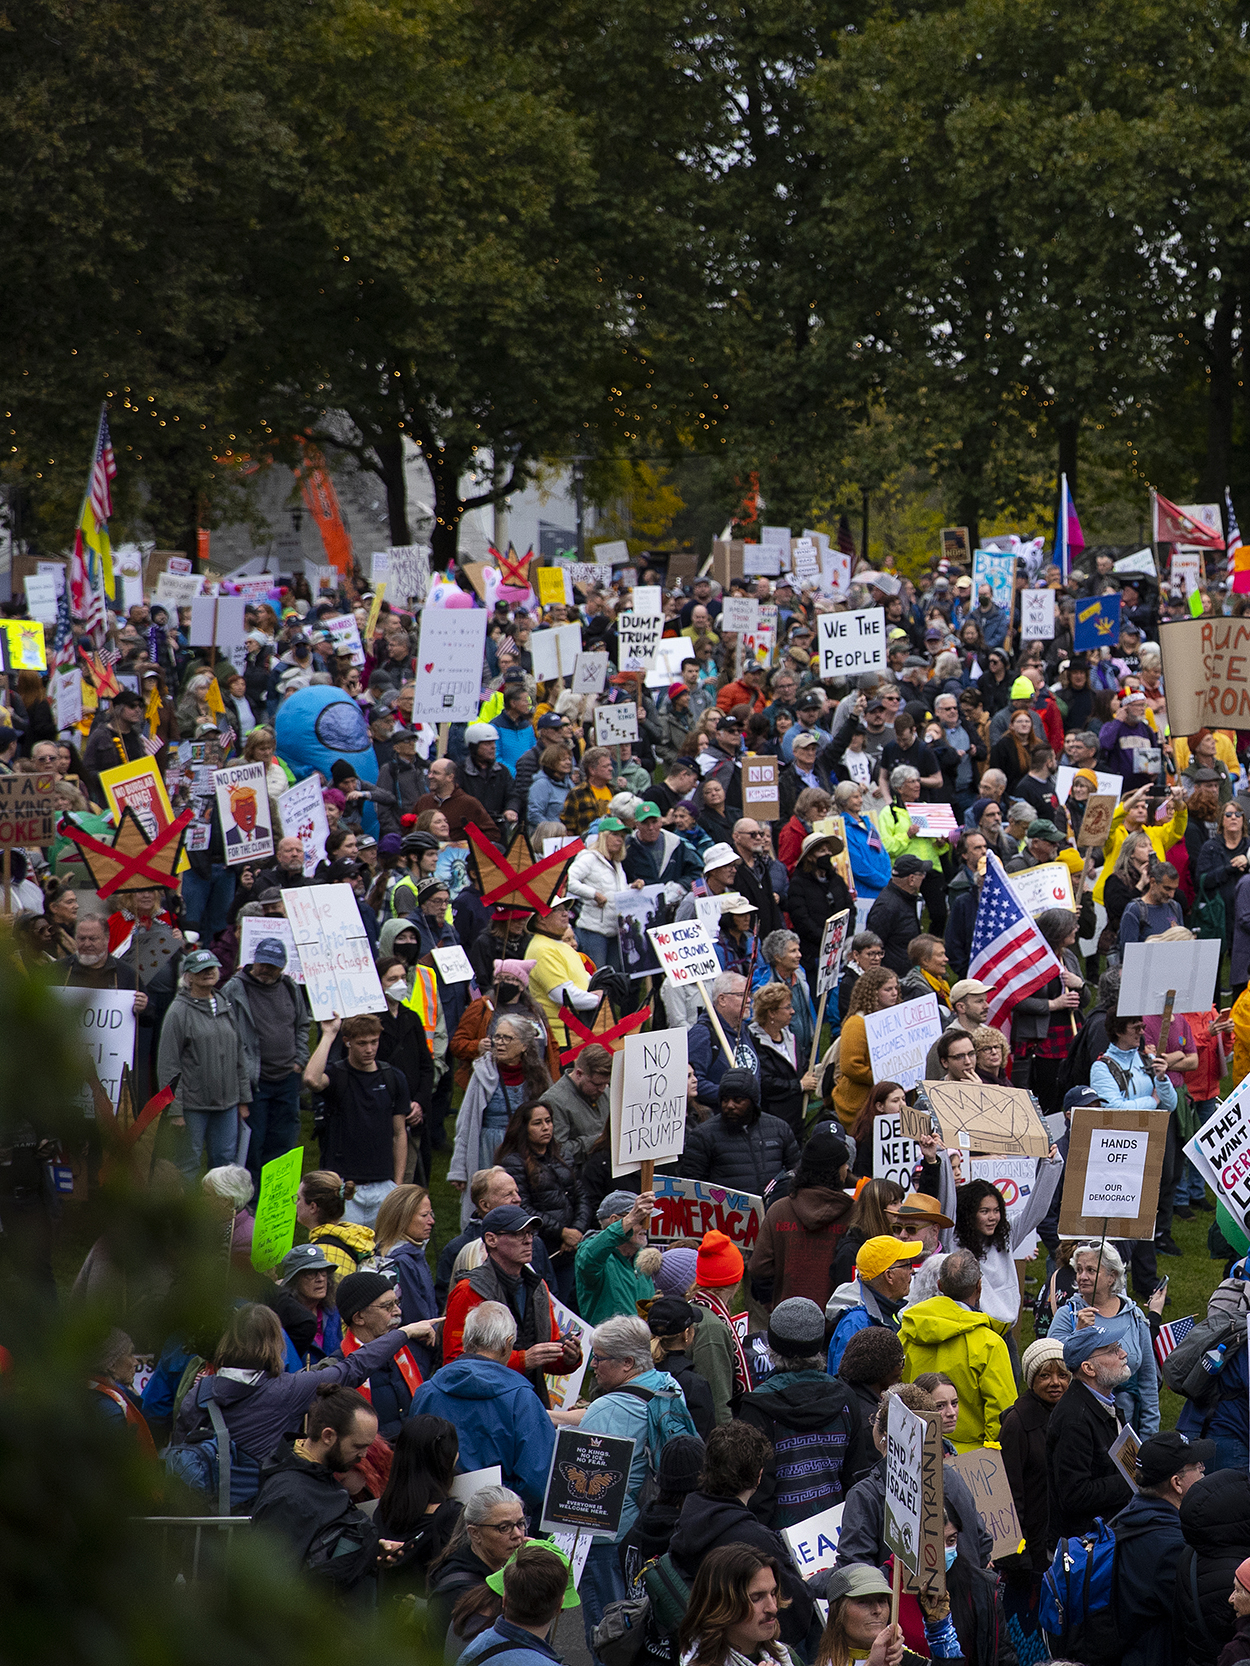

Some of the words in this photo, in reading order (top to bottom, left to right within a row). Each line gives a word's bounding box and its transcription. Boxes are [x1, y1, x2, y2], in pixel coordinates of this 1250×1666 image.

[621, 615, 661, 630] DUMP
[825, 620, 848, 639] WE
[856, 615, 881, 637] THE
[620, 631, 659, 644] TRUMP
[628, 646, 656, 659] NOW
[824, 648, 881, 670] PEOPLE
[216, 772, 230, 786] NO
[230, 765, 264, 784] CROWN
[750, 770, 774, 781] NO
[21, 778, 36, 795] A
[114, 786, 128, 799] NO
[125, 775, 156, 795] BURGLAR
[123, 788, 153, 806] KING!
[748, 789, 777, 800] KINGS
[227, 846, 240, 858] FOR
[240, 844, 251, 855] THE
[251, 840, 273, 853] CLOWN
[657, 932, 671, 945] NO
[671, 926, 700, 942] KINGS
[663, 950, 679, 963] NO
[678, 942, 709, 960] CROWNS
[671, 967, 688, 980] NO
[684, 958, 715, 977] TRUMP
[871, 1011, 902, 1040] WHEN
[903, 999, 938, 1027] CRUELTY
[642, 1040, 671, 1071] NO
[871, 1037, 907, 1062] BECOMES
[874, 1046, 924, 1079] COMPASSION
[642, 1071, 668, 1100] TO
[625, 1095, 686, 1127] TYRANT
[1199, 1102, 1243, 1149] THEY
[622, 1120, 684, 1155] TRUMP
[1100, 1138, 1139, 1151] HANDS
[1209, 1125, 1249, 1171] WANT
[1106, 1153, 1129, 1164] OFF
[972, 1160, 993, 1178] NO
[993, 1160, 1036, 1179] KINGS
[653, 1175, 686, 1199] I
[1104, 1183, 1123, 1192] OUR
[1089, 1193, 1137, 1203] DEMOCRACY
[649, 1195, 760, 1248] AMERICA
[587, 1448, 611, 1457] KINGS.
[591, 1454, 606, 1462] ICE.
[888, 1435, 907, 1466] END
[587, 1458, 608, 1467] FEAR.
[897, 1466, 910, 1487] AID
[908, 1475, 919, 1494] TO
[566, 1499, 597, 1510] EVERYONE
[887, 1471, 919, 1518] ISRAEL
[558, 1502, 590, 1513] WELCOME
[590, 1508, 609, 1517] HERE.
